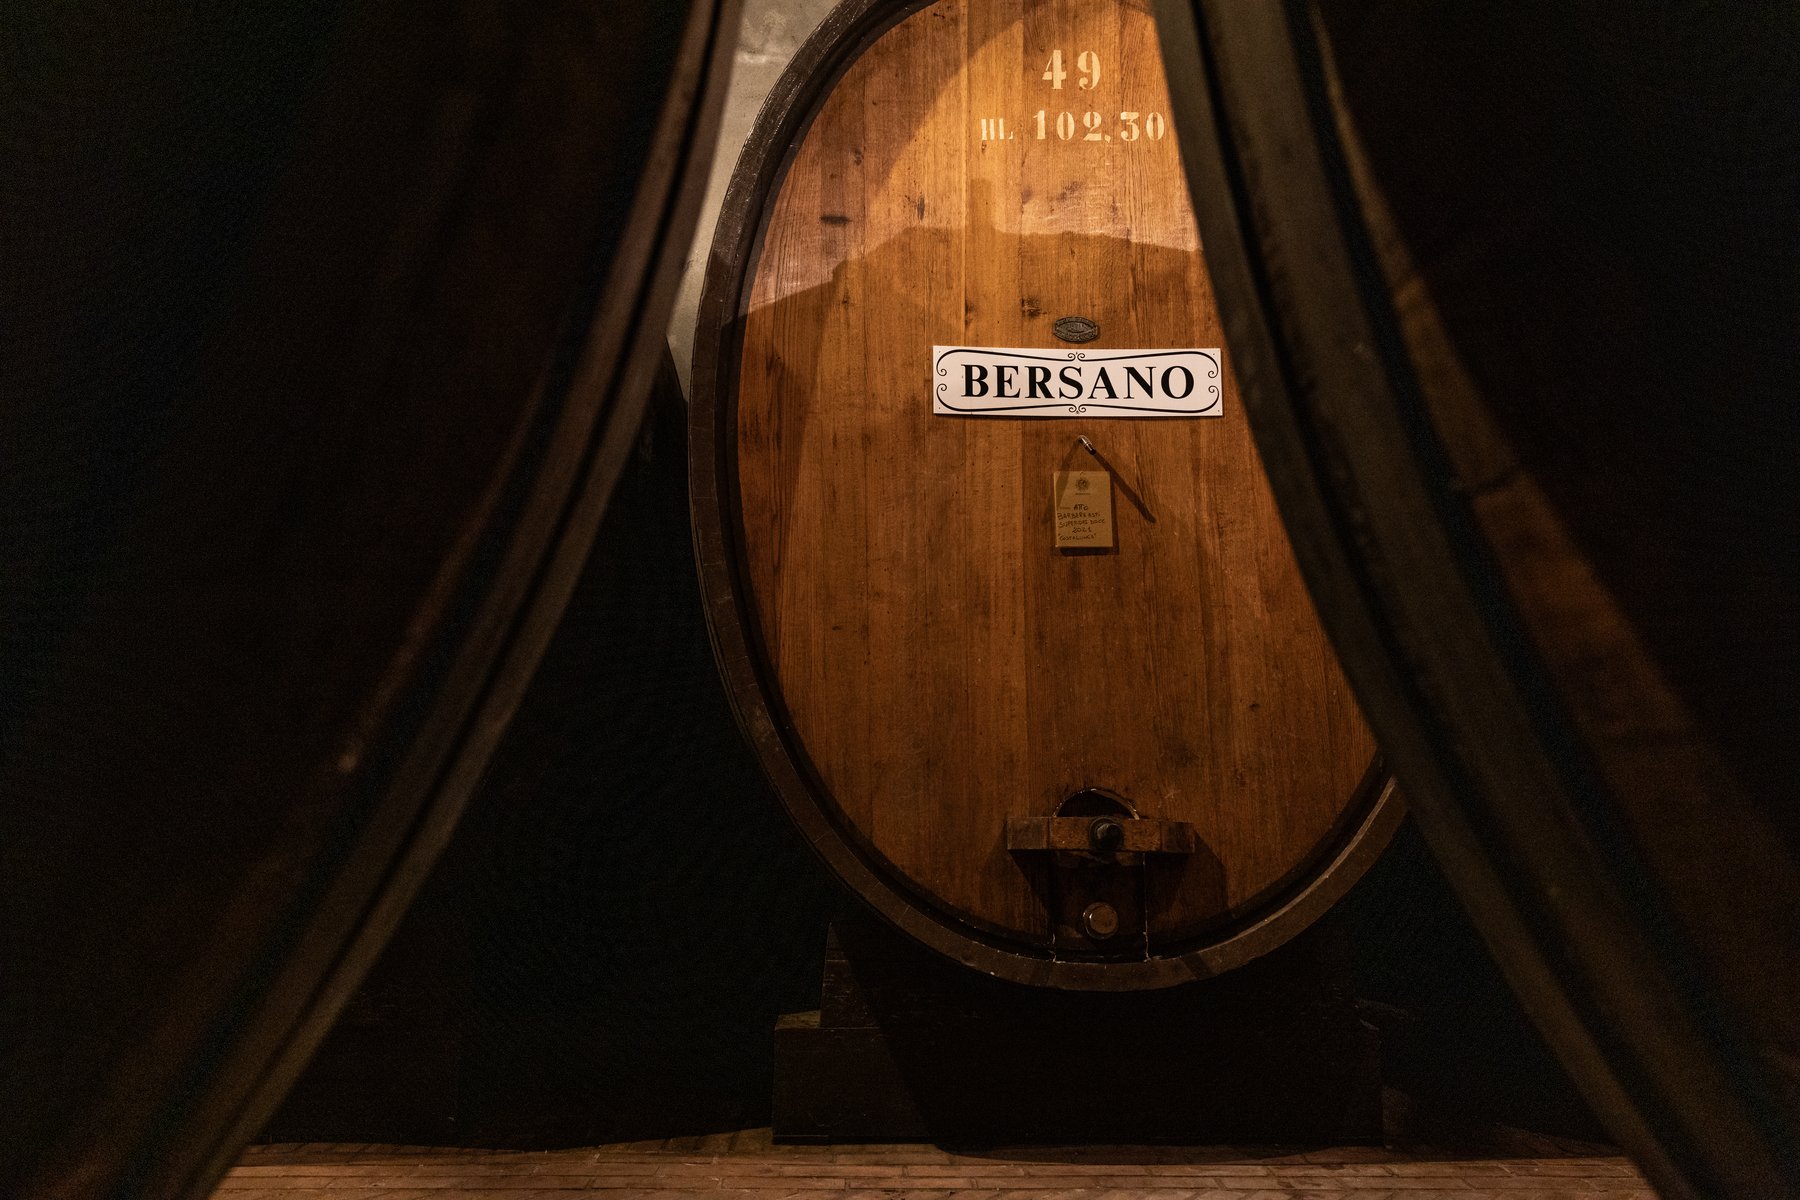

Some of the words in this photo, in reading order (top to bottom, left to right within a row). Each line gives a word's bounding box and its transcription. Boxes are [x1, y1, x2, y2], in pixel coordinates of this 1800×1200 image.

[1042, 49, 1101, 89] 49
[960, 363, 1194, 400] BERSANO
[1072, 526, 1092, 534] 2021
